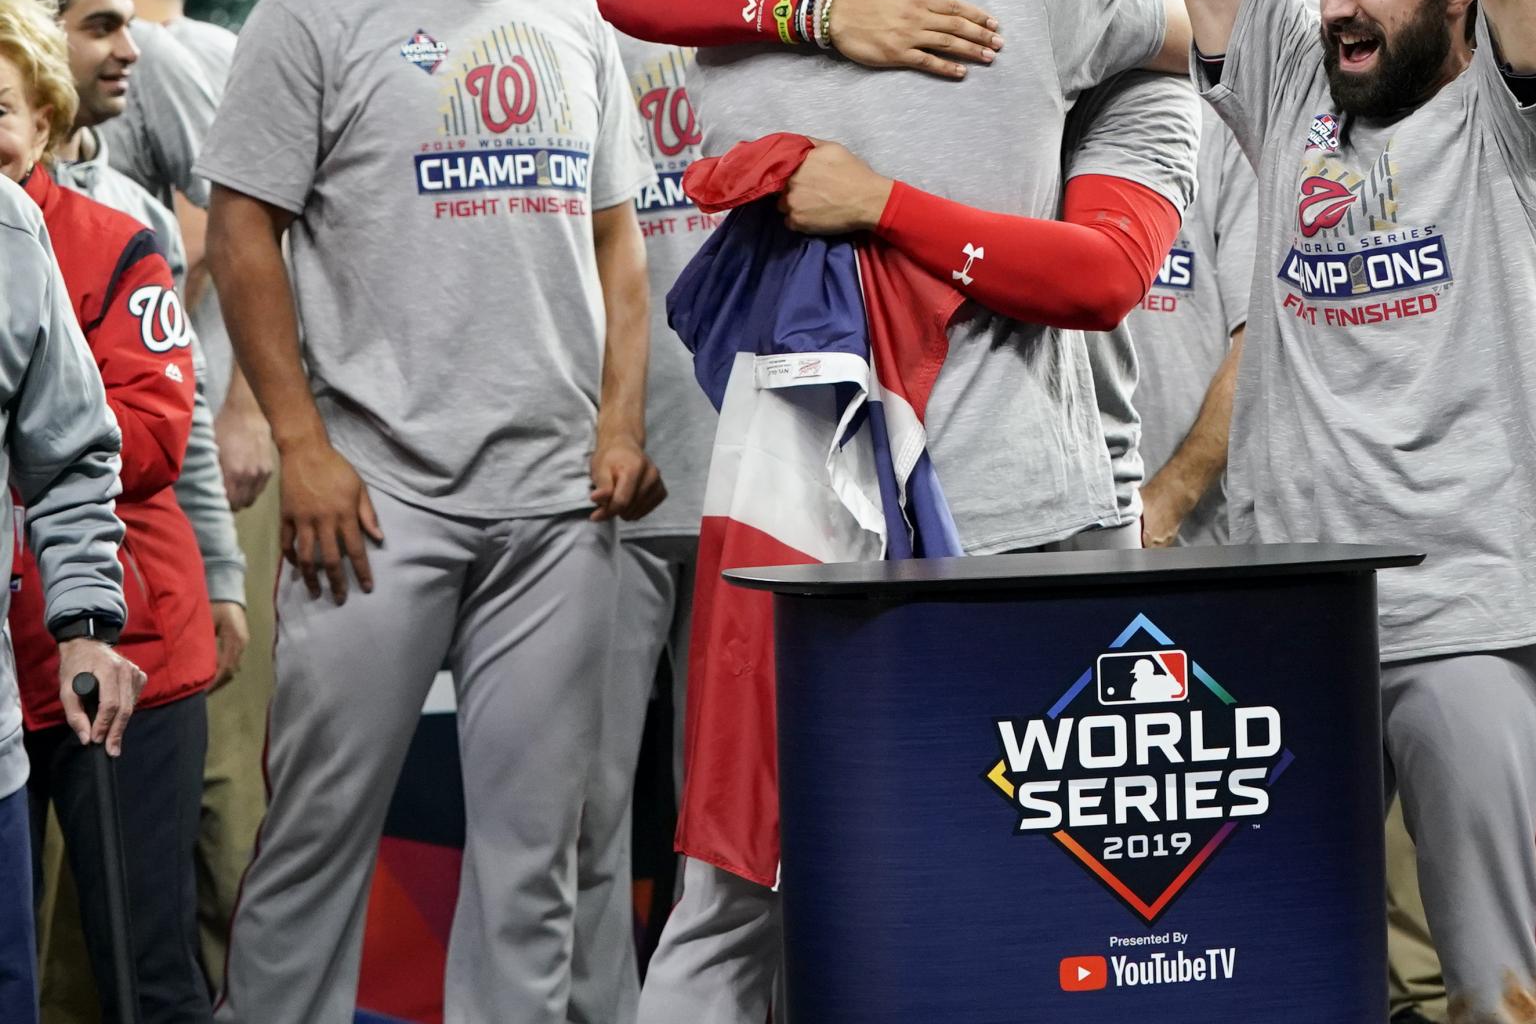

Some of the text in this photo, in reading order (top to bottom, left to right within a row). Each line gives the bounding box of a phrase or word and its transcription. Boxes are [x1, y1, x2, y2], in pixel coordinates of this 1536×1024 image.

[465, 54, 538, 135] W
[478, 137, 537, 148] WORLD
[434, 198, 499, 219] FIGHT
[1301, 241, 1346, 254] ORLD
[1325, 293, 1439, 327] FINISHED
[997, 705, 1282, 773] WORLD
[1018, 767, 1270, 831] SERIES
[1102, 831, 1193, 861] 2019
[1109, 931, 1189, 948] Presented By
